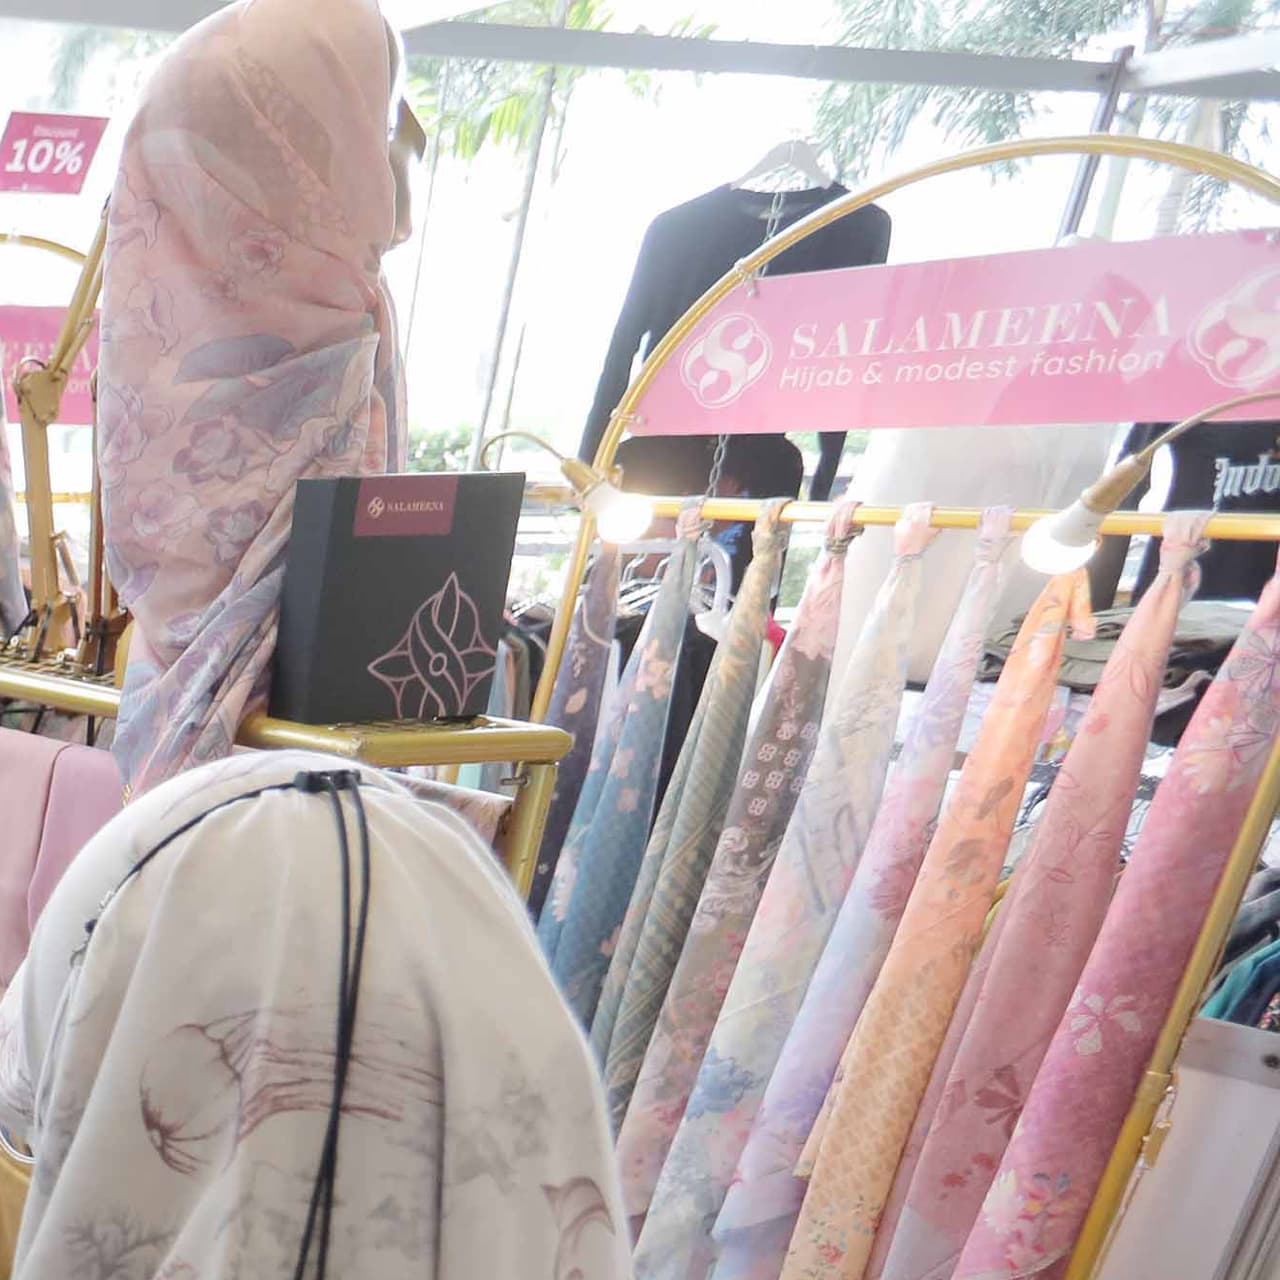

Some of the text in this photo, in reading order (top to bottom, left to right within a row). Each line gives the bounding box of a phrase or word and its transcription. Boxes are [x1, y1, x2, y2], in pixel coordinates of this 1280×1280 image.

[5, 138, 85, 176] 10%
[788, 295, 1172, 360] SALAMEENA
[779, 347, 1165, 393] Hijab & modest fashion
